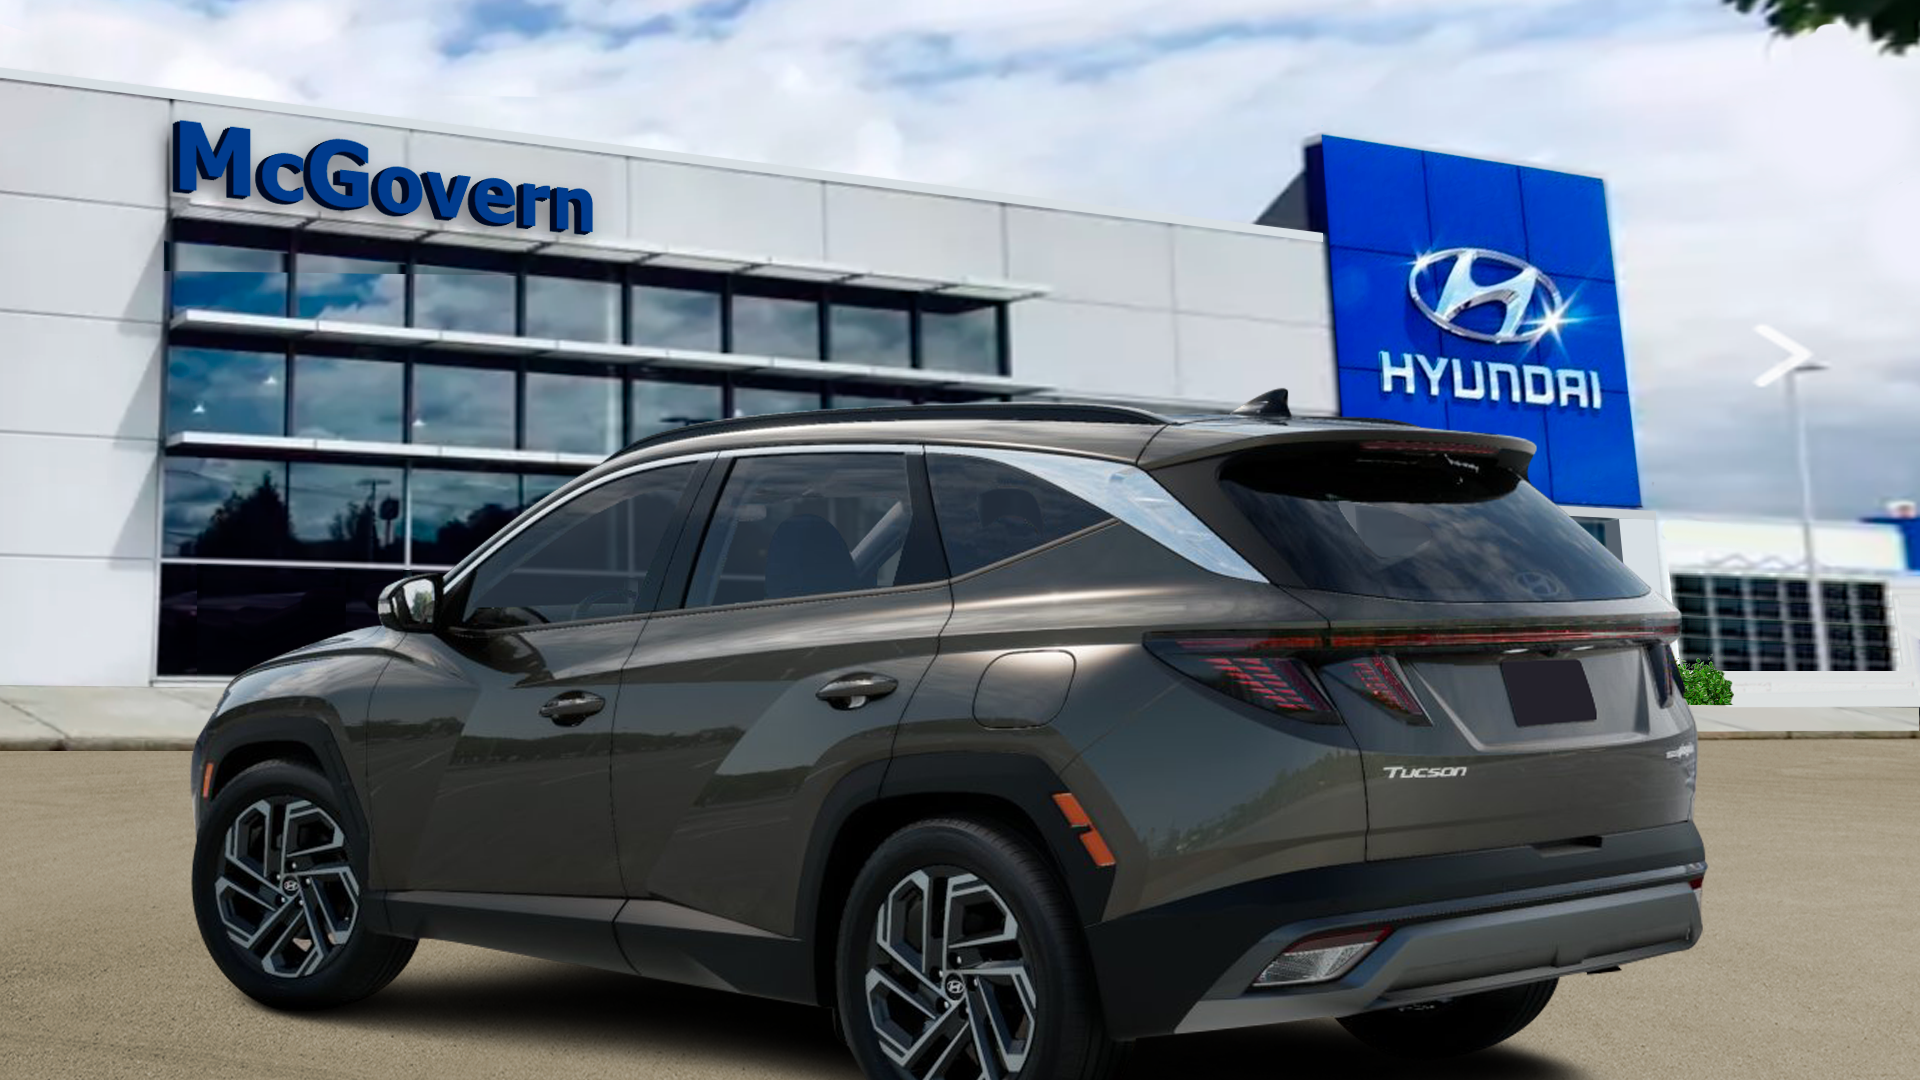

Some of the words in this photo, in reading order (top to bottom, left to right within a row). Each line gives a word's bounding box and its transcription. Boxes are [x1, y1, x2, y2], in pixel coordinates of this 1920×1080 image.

[172, 119, 594, 235] McGovern
[1379, 350, 1602, 409] HYUNDAI
[1383, 766, 1467, 779] Tucson
